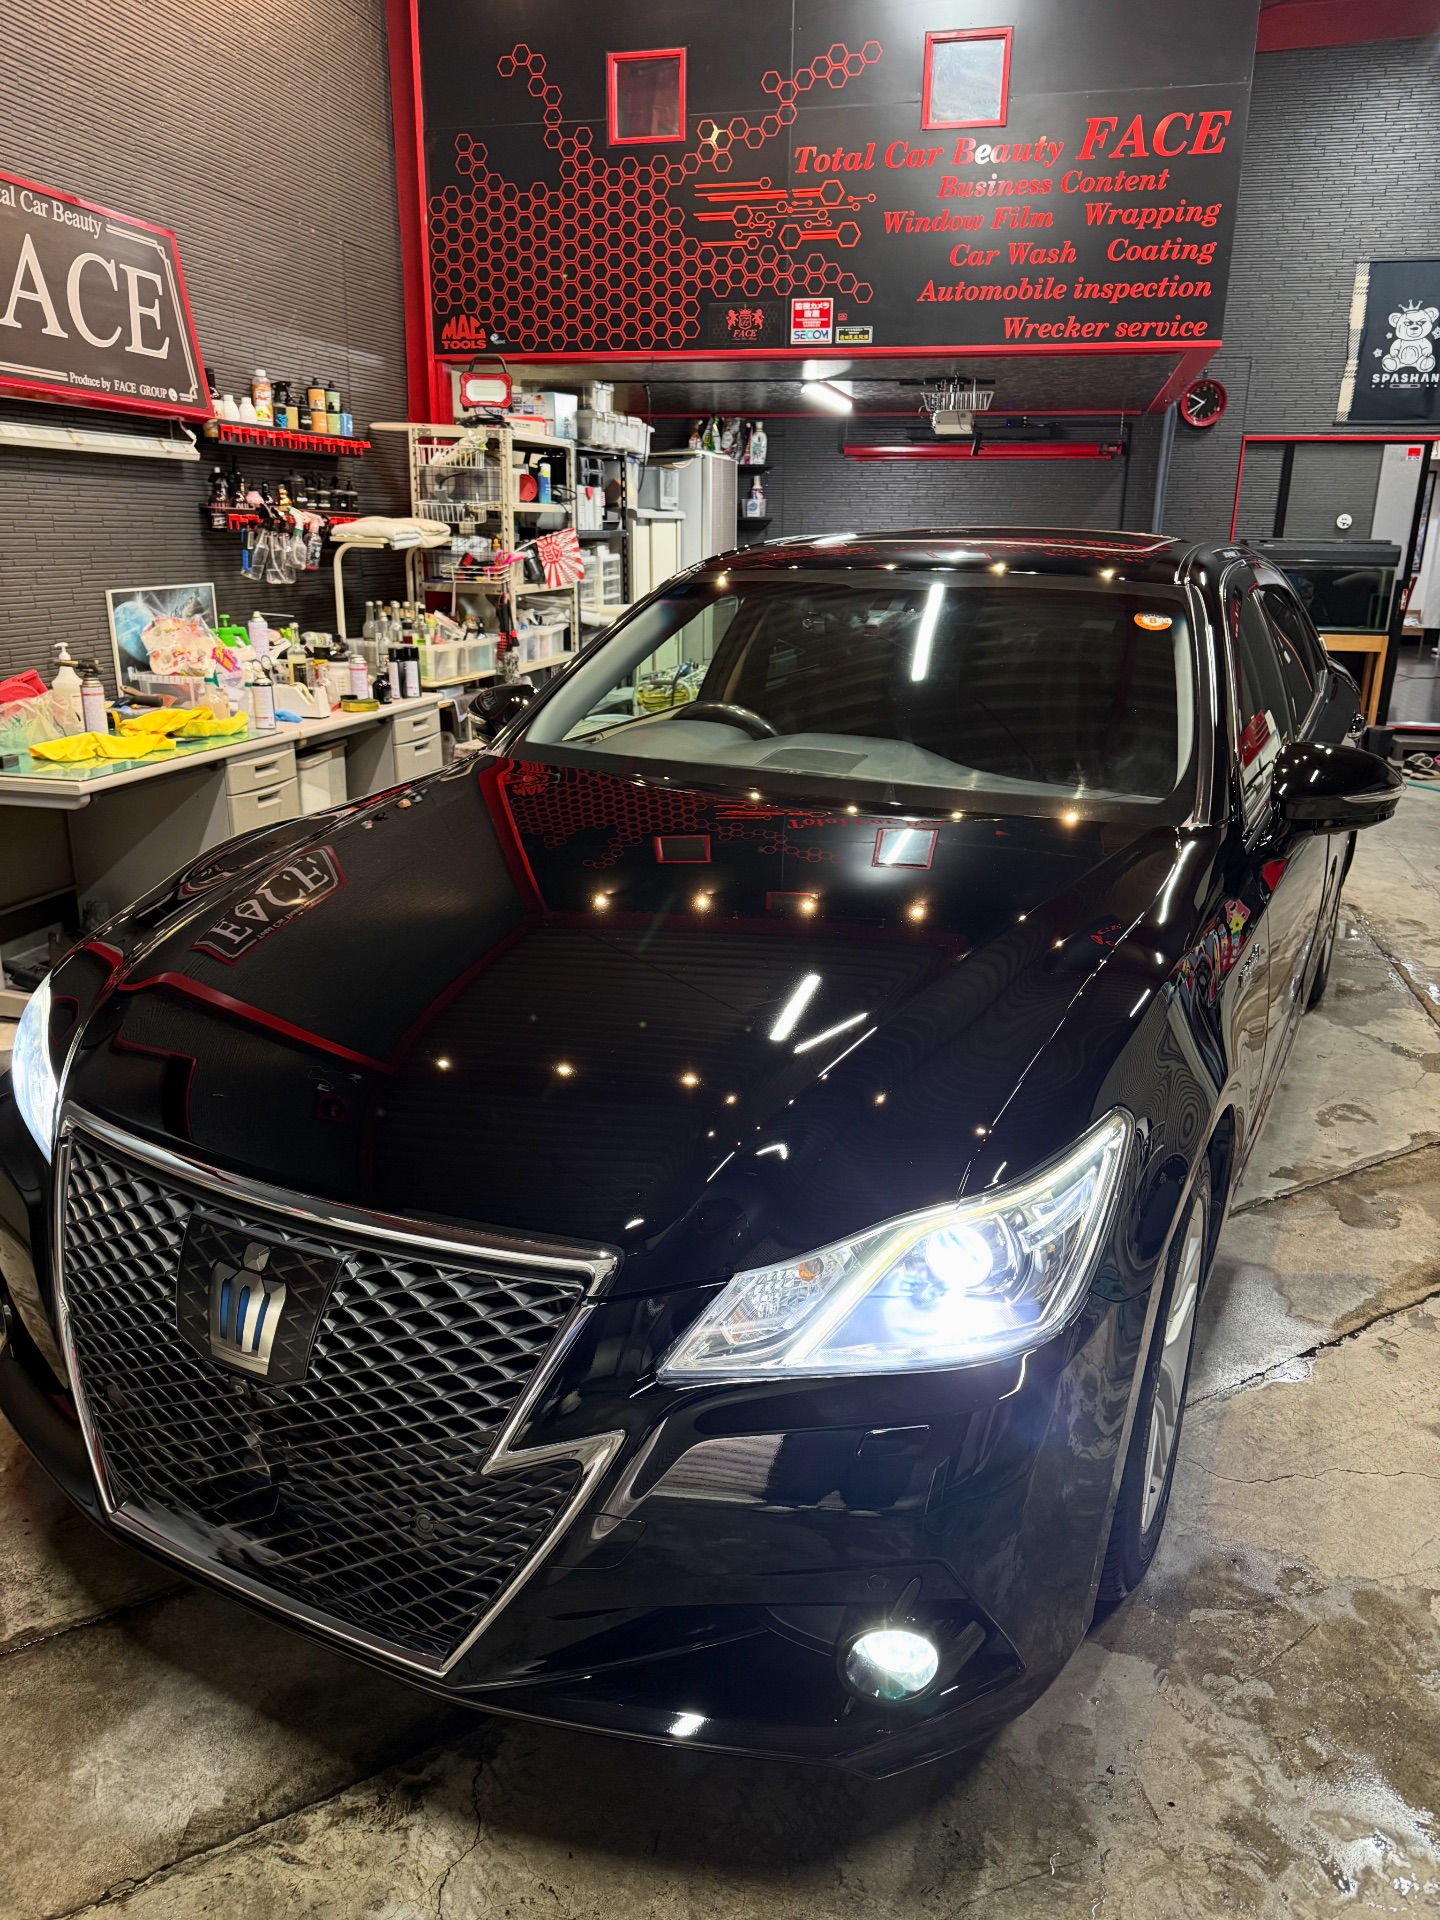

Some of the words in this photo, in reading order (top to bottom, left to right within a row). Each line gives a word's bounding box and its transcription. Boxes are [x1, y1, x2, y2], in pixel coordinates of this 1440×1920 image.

[794, 142, 876, 174] Total
[884, 141, 945, 169] Car
[950, 136, 1065, 168] Beauty
[1075, 110, 1232, 160] FACE
[937, 173, 1053, 199] Business
[1061, 169, 1170, 194] Content
[0, 185, 17, 208] al
[20, 190, 49, 218] Car
[51, 200, 102, 240] Beauty
[884, 209, 985, 234] Window
[990, 206, 1054, 230] Film
[1085, 199, 1223, 230] Wrapping
[950, 244, 1001, 267] Car
[1008, 241, 1077, 265] Wash
[1107, 237, 1218, 266] Coating
[917, 277, 1067, 302] Automobile
[1073, 275, 1212, 304] inspection
[733, 330, 758, 338] FACE
[793, 330, 829, 340] SECOM
[1004, 316, 1110, 340] Wrecker
[1115, 315, 1208, 338] service
[441, 340, 487, 350] TOOLS
[69, 372, 101, 388] Produce
[101, 377, 111, 391] by
[114, 380, 137, 394] FACE
[139, 384, 168, 399] GROUP
[1371, 373, 1440, 383] SPASHAN
